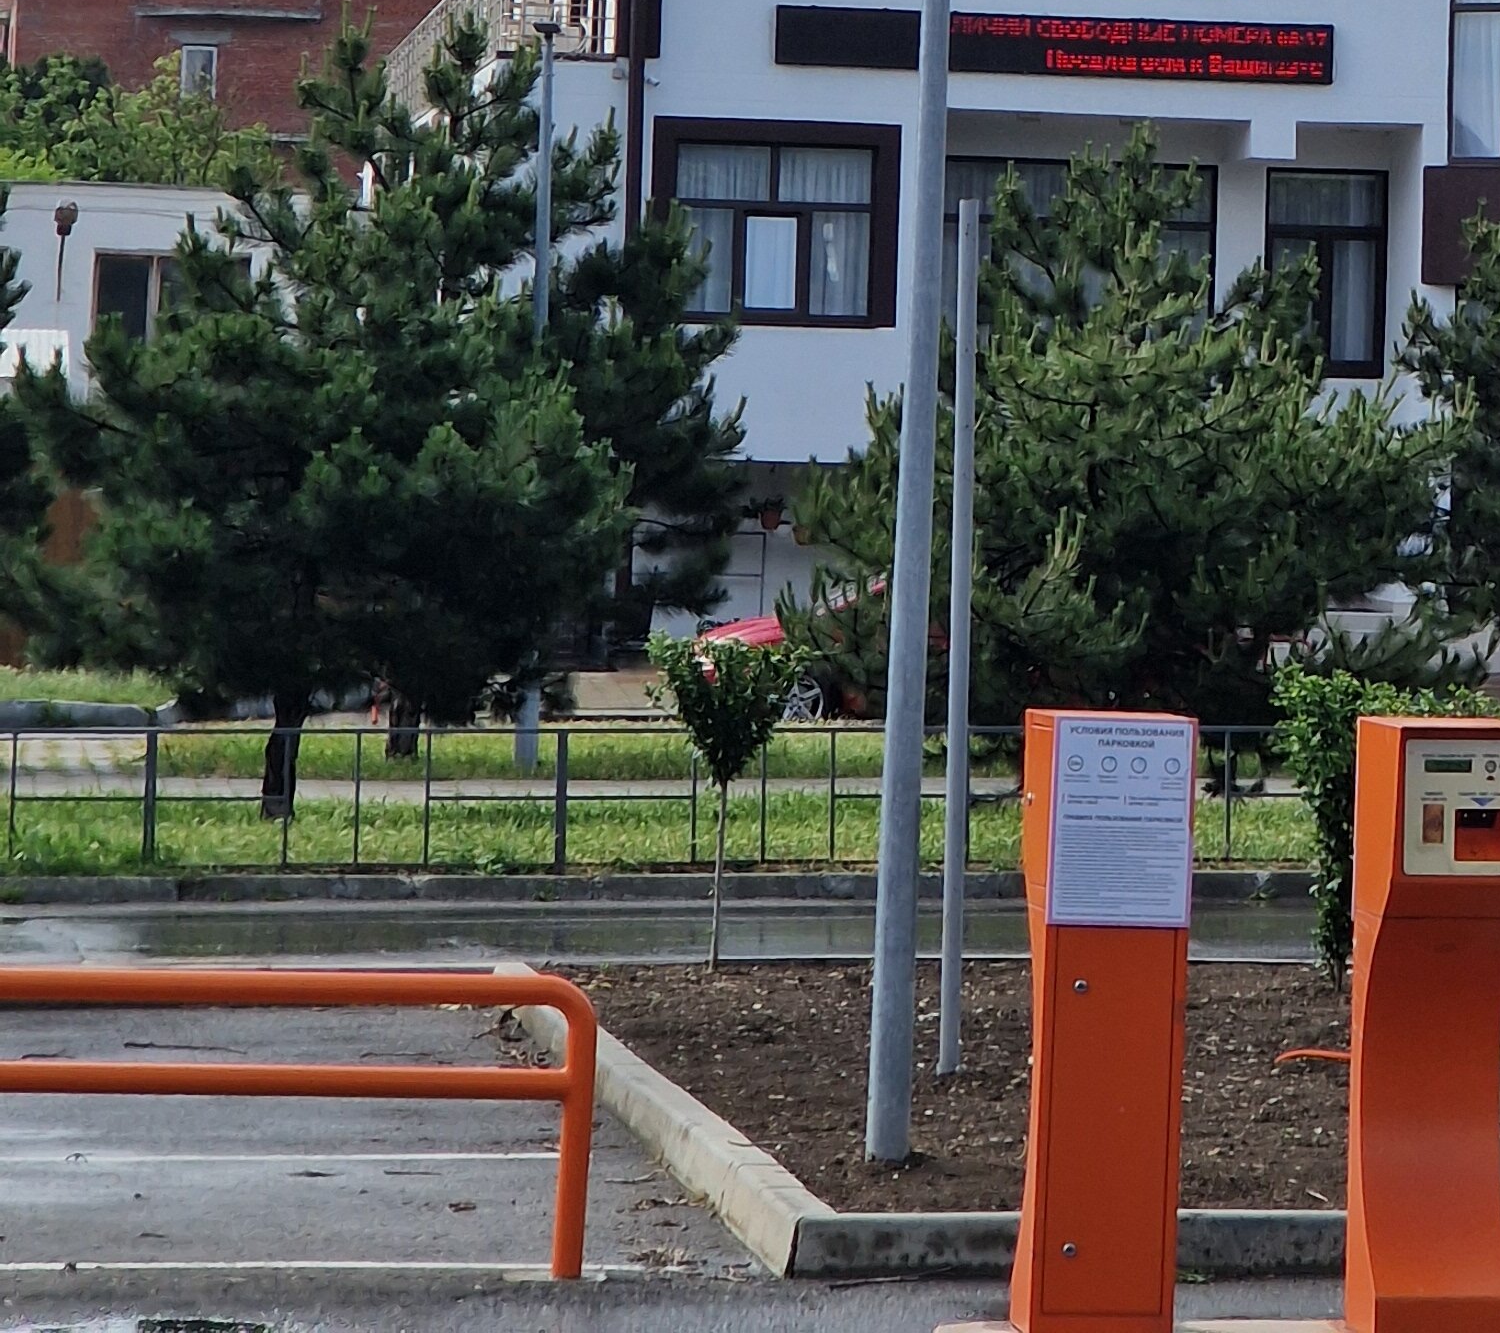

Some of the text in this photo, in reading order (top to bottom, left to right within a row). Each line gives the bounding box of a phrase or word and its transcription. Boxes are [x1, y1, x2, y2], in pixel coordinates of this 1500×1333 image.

[1070, 726, 1184, 737] УСЛОВИЯ ПОЛЬЗОВАНИЯ
[1098, 739, 1155, 748] ПАРКОВКОЙ
